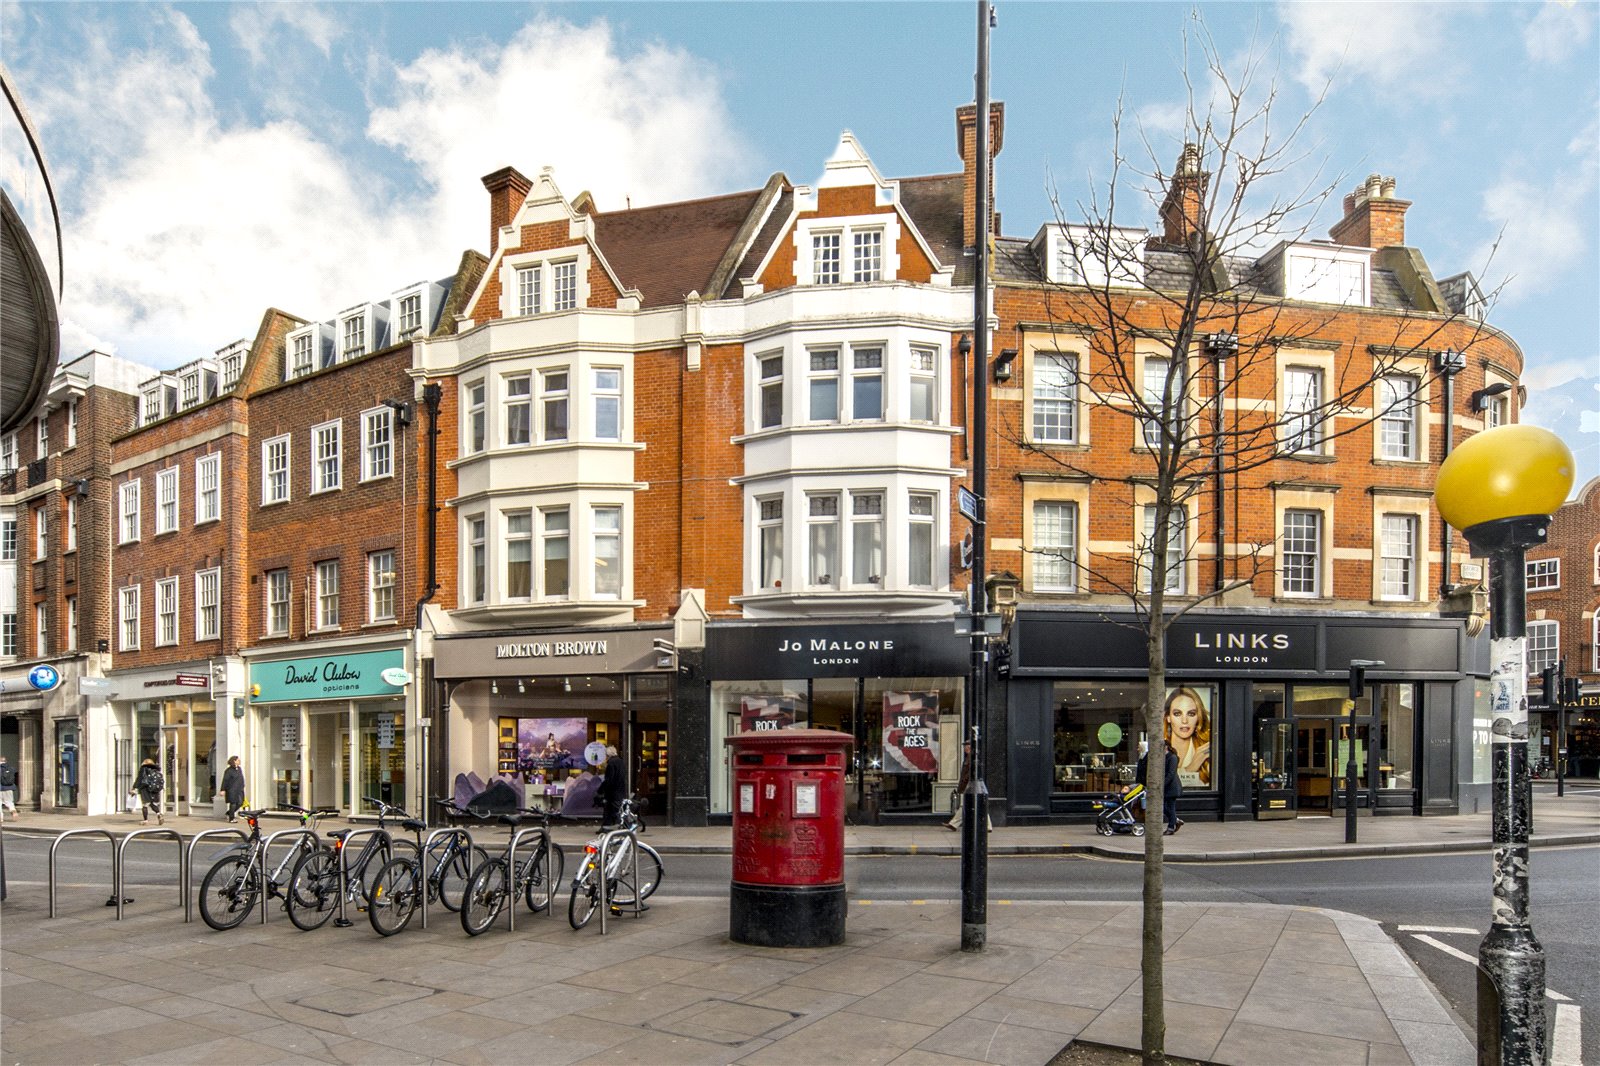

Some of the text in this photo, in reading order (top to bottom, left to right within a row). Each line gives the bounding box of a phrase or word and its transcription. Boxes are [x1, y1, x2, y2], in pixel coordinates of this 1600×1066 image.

[810, 639, 894, 651] MALONE
[1195, 632, 1289, 649] LINKS
[496, 640, 607, 659] MOLTON BROWN
[285, 661, 361, 685] David Clulow
[323, 684, 360, 693] opticians
[755, 719, 778, 732] ROCK
[897, 715, 921, 728] ROCK
[903, 735, 925, 748] AGES
